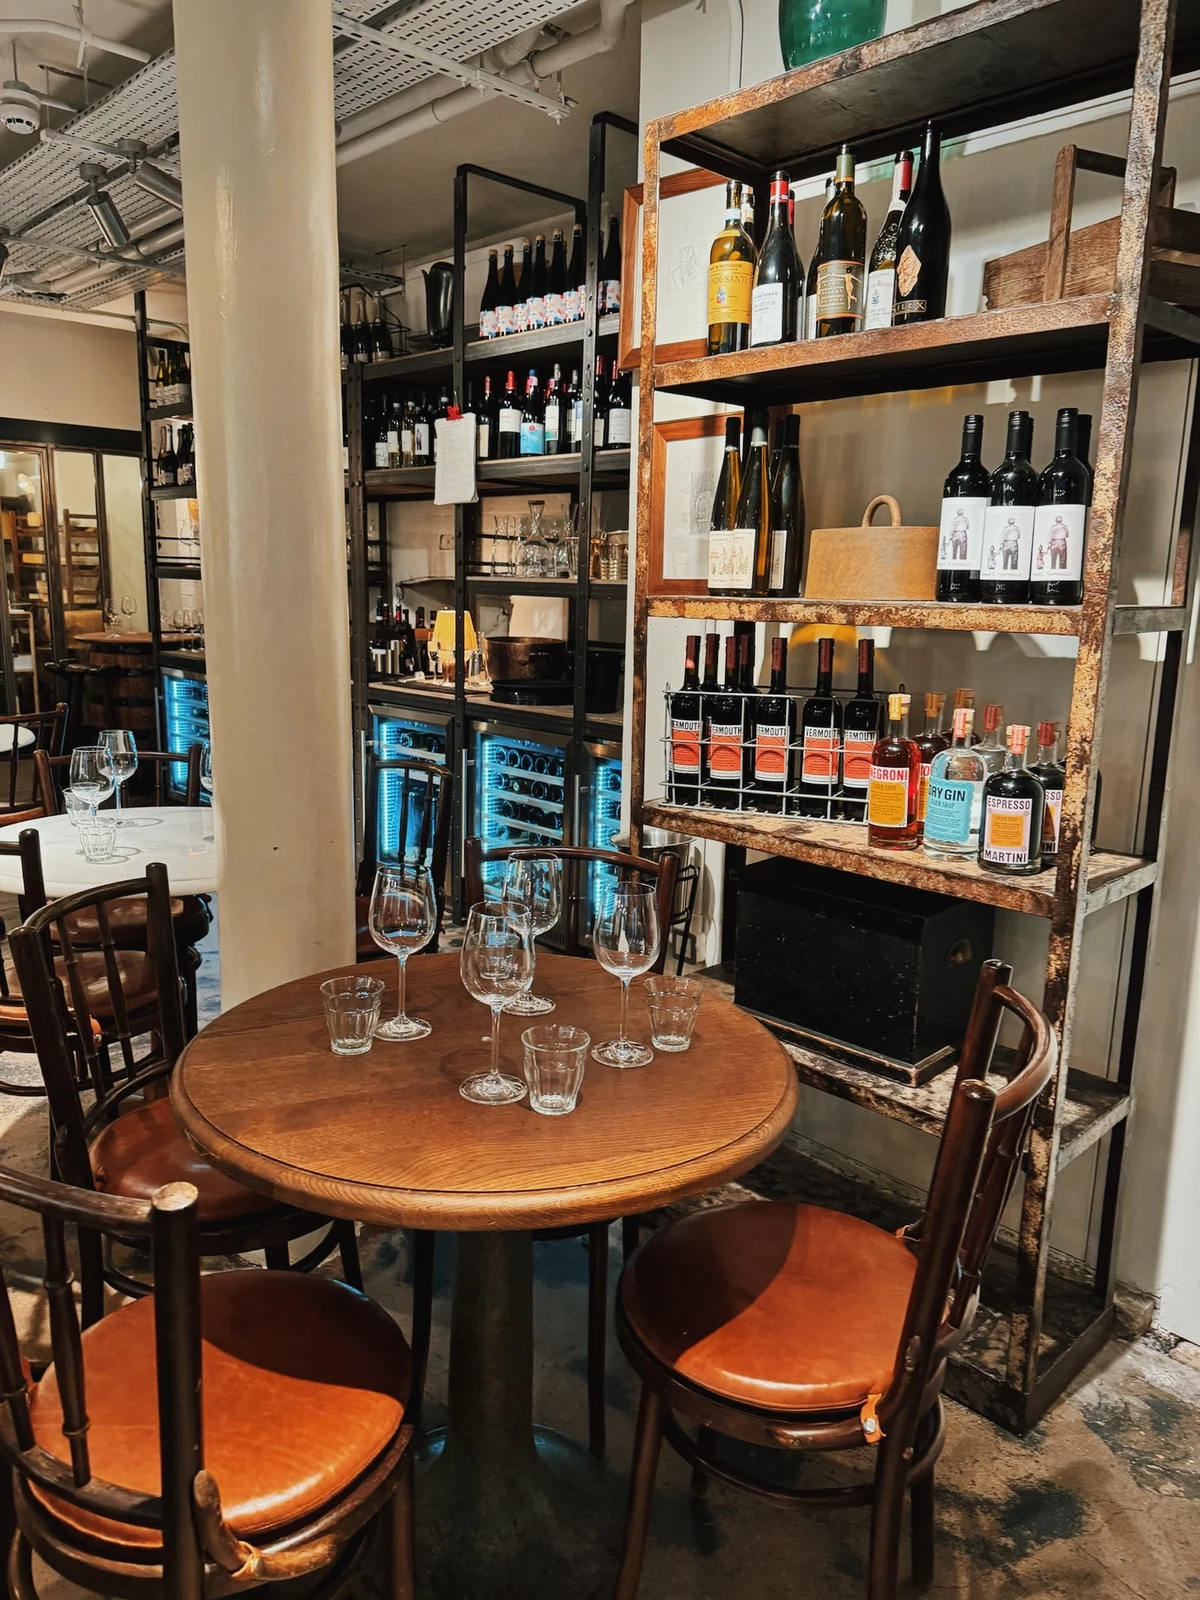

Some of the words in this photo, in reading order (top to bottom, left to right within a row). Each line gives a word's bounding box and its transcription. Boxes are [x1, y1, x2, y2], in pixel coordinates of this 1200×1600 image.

[944, 789, 966, 802] GIN
[988, 797, 1031, 810] ESPRESSO
[984, 849, 1027, 863] MARTINI
